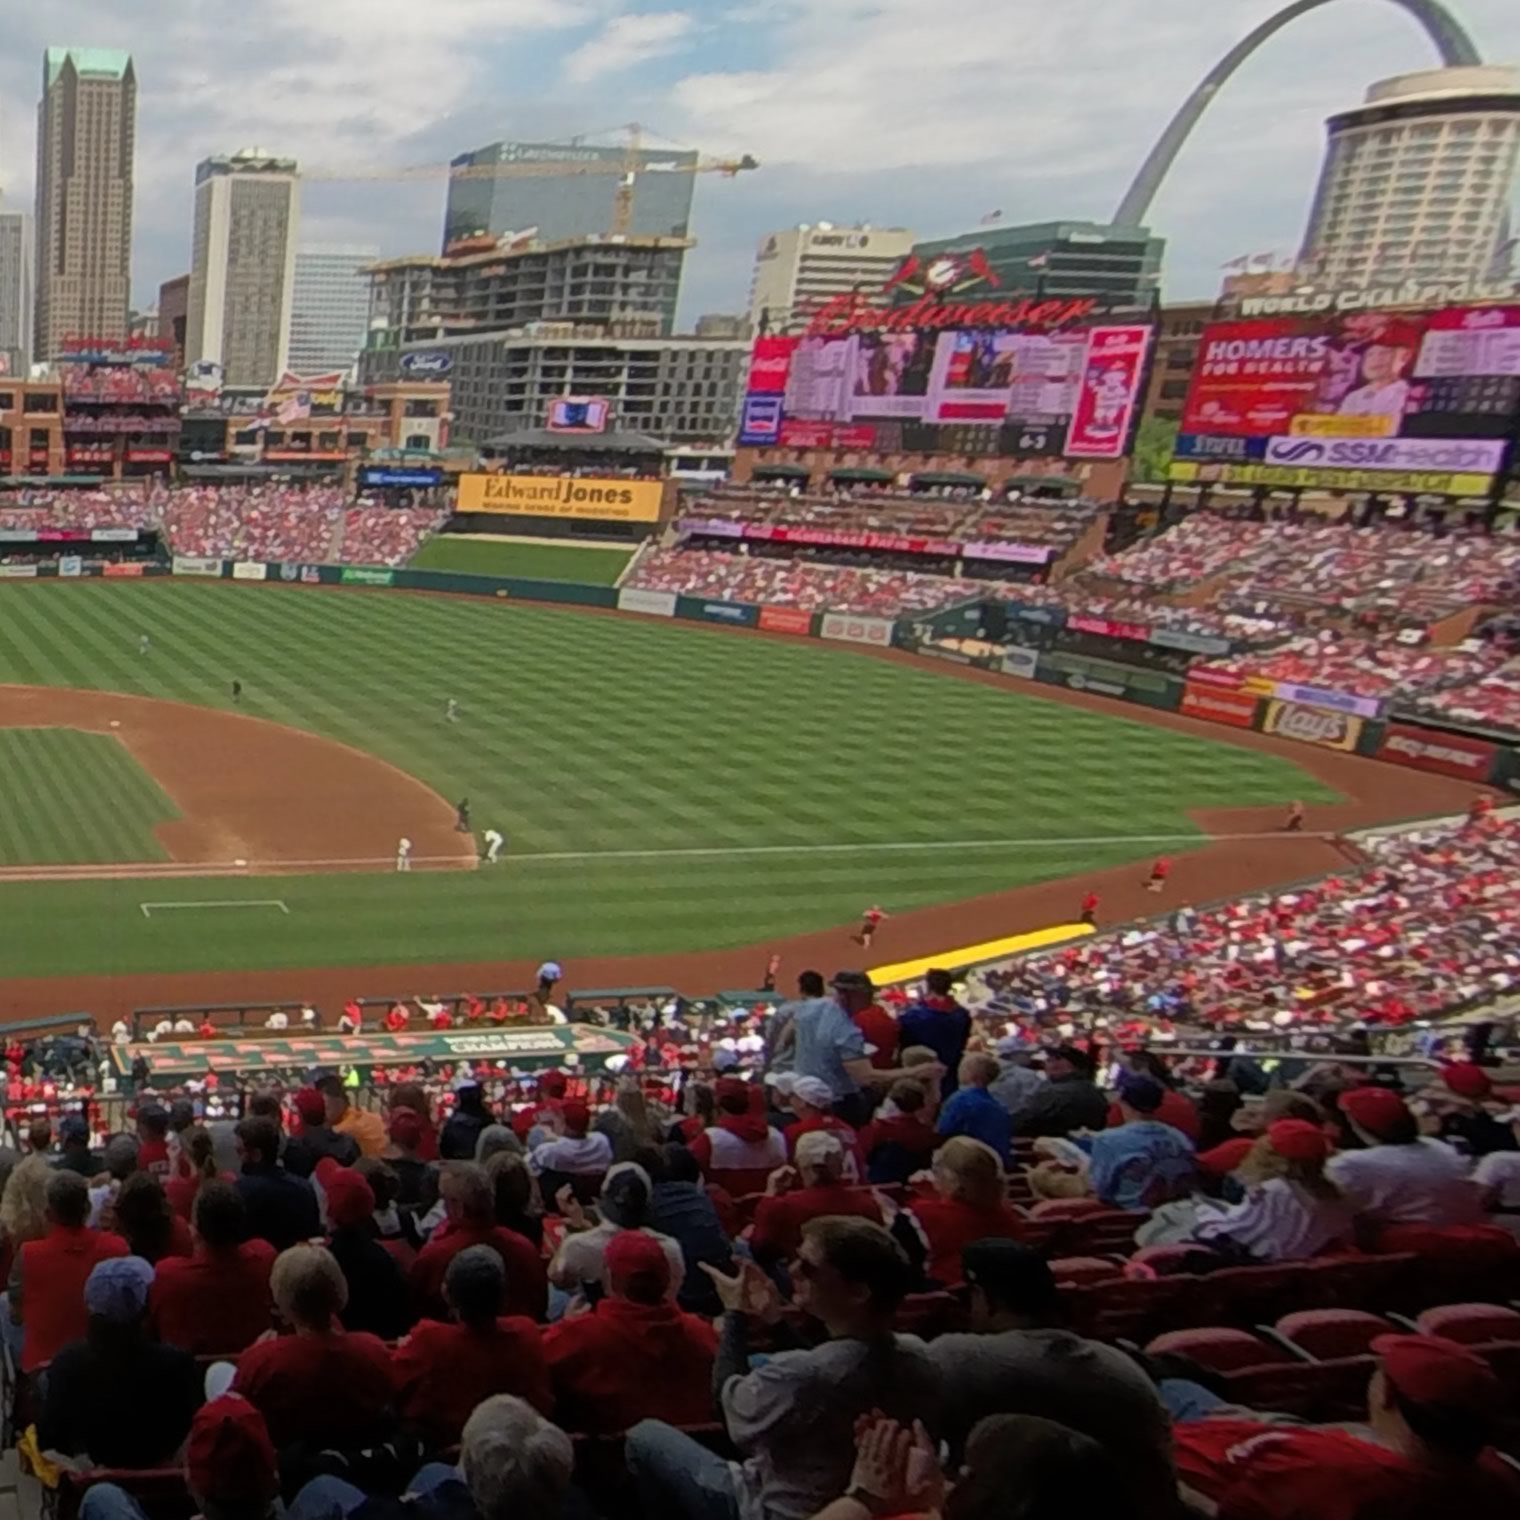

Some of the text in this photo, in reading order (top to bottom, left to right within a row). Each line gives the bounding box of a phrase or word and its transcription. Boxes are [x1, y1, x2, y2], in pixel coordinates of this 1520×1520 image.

[802, 290, 1099, 334] Budweiser
[1241, 293, 1330, 316] WORLD
[1205, 336, 1329, 361] HOMERS
[483, 478, 633, 505] Edward Jones
